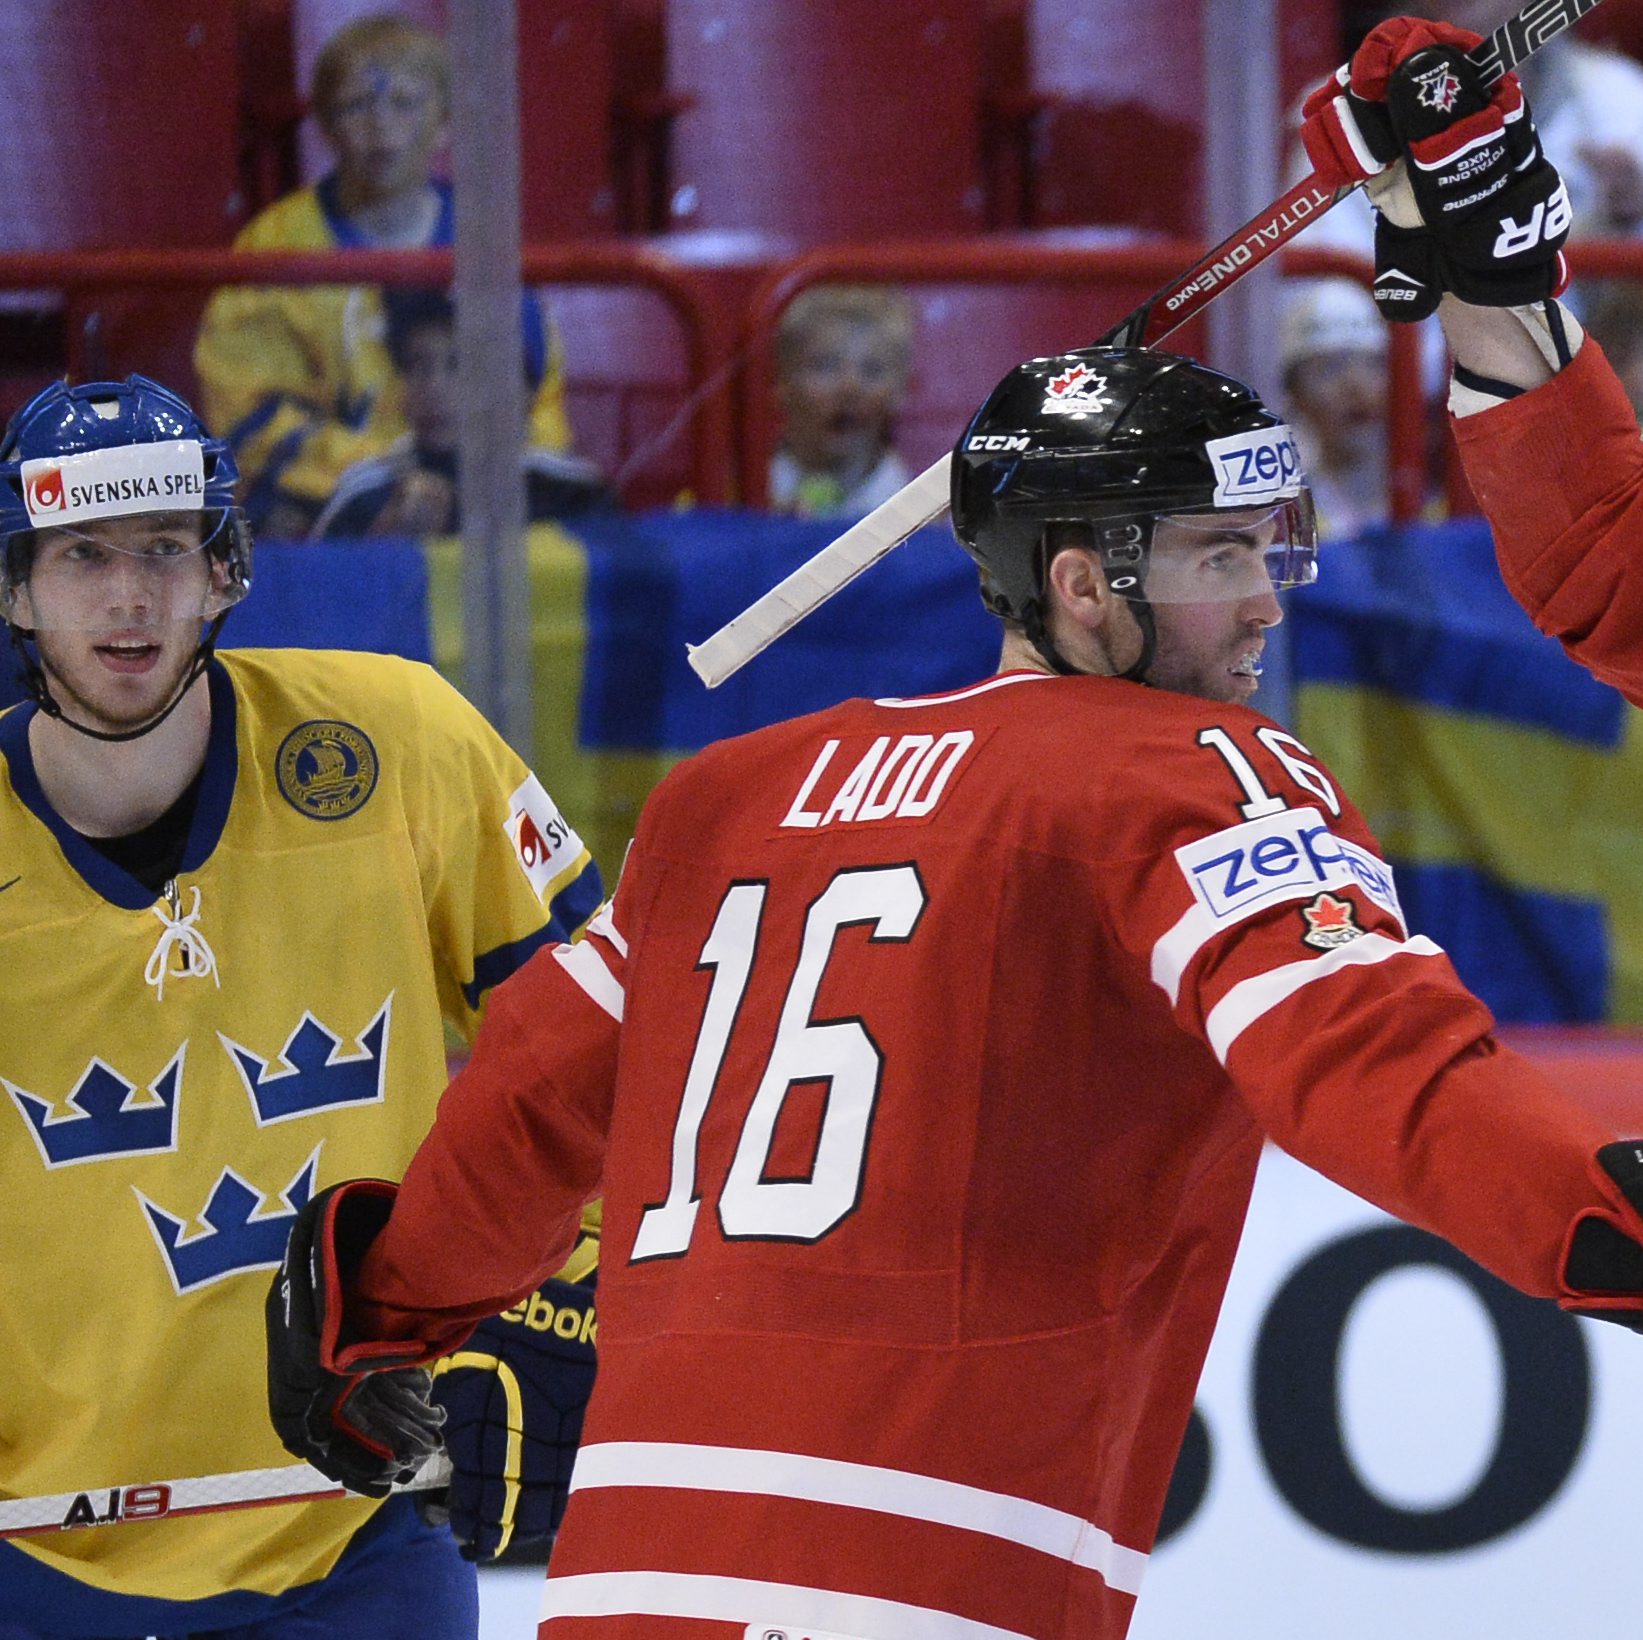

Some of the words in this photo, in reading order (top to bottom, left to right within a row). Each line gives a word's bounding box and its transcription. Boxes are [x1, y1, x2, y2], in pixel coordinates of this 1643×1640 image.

[1457, 147, 1491, 172] NXG
[967, 435, 1031, 451] CCM
[70, 477, 160, 508] SVENSKA
[163, 473, 203, 496] SPEL
[779, 729, 976, 828] LADD
[1196, 725, 1341, 821] 16
[627, 859, 930, 1266] 16
